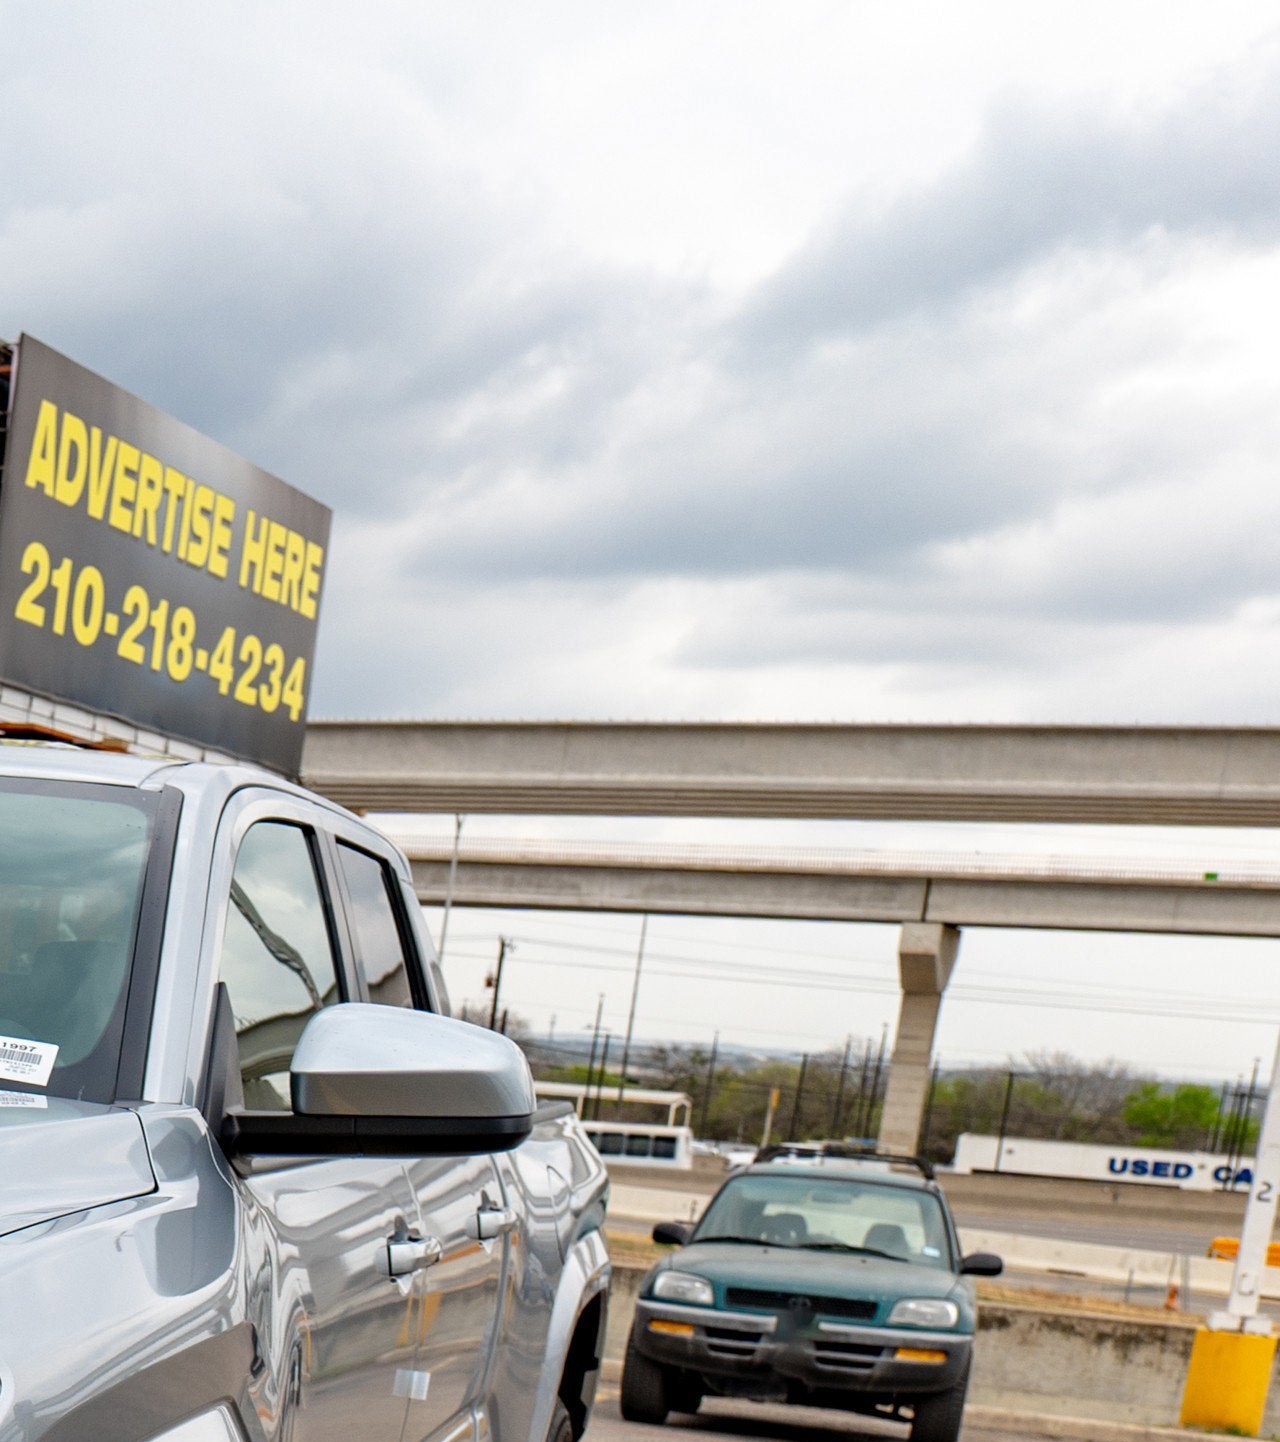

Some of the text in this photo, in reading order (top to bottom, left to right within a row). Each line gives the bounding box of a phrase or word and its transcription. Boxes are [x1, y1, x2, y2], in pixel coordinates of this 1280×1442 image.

[24, 399, 324, 620] ADVERTISE HERE
[13, 540, 306, 723] 210-218-4234
[1108, 1156, 1194, 1179] USED
[1256, 1181, 1272, 1202] 2
